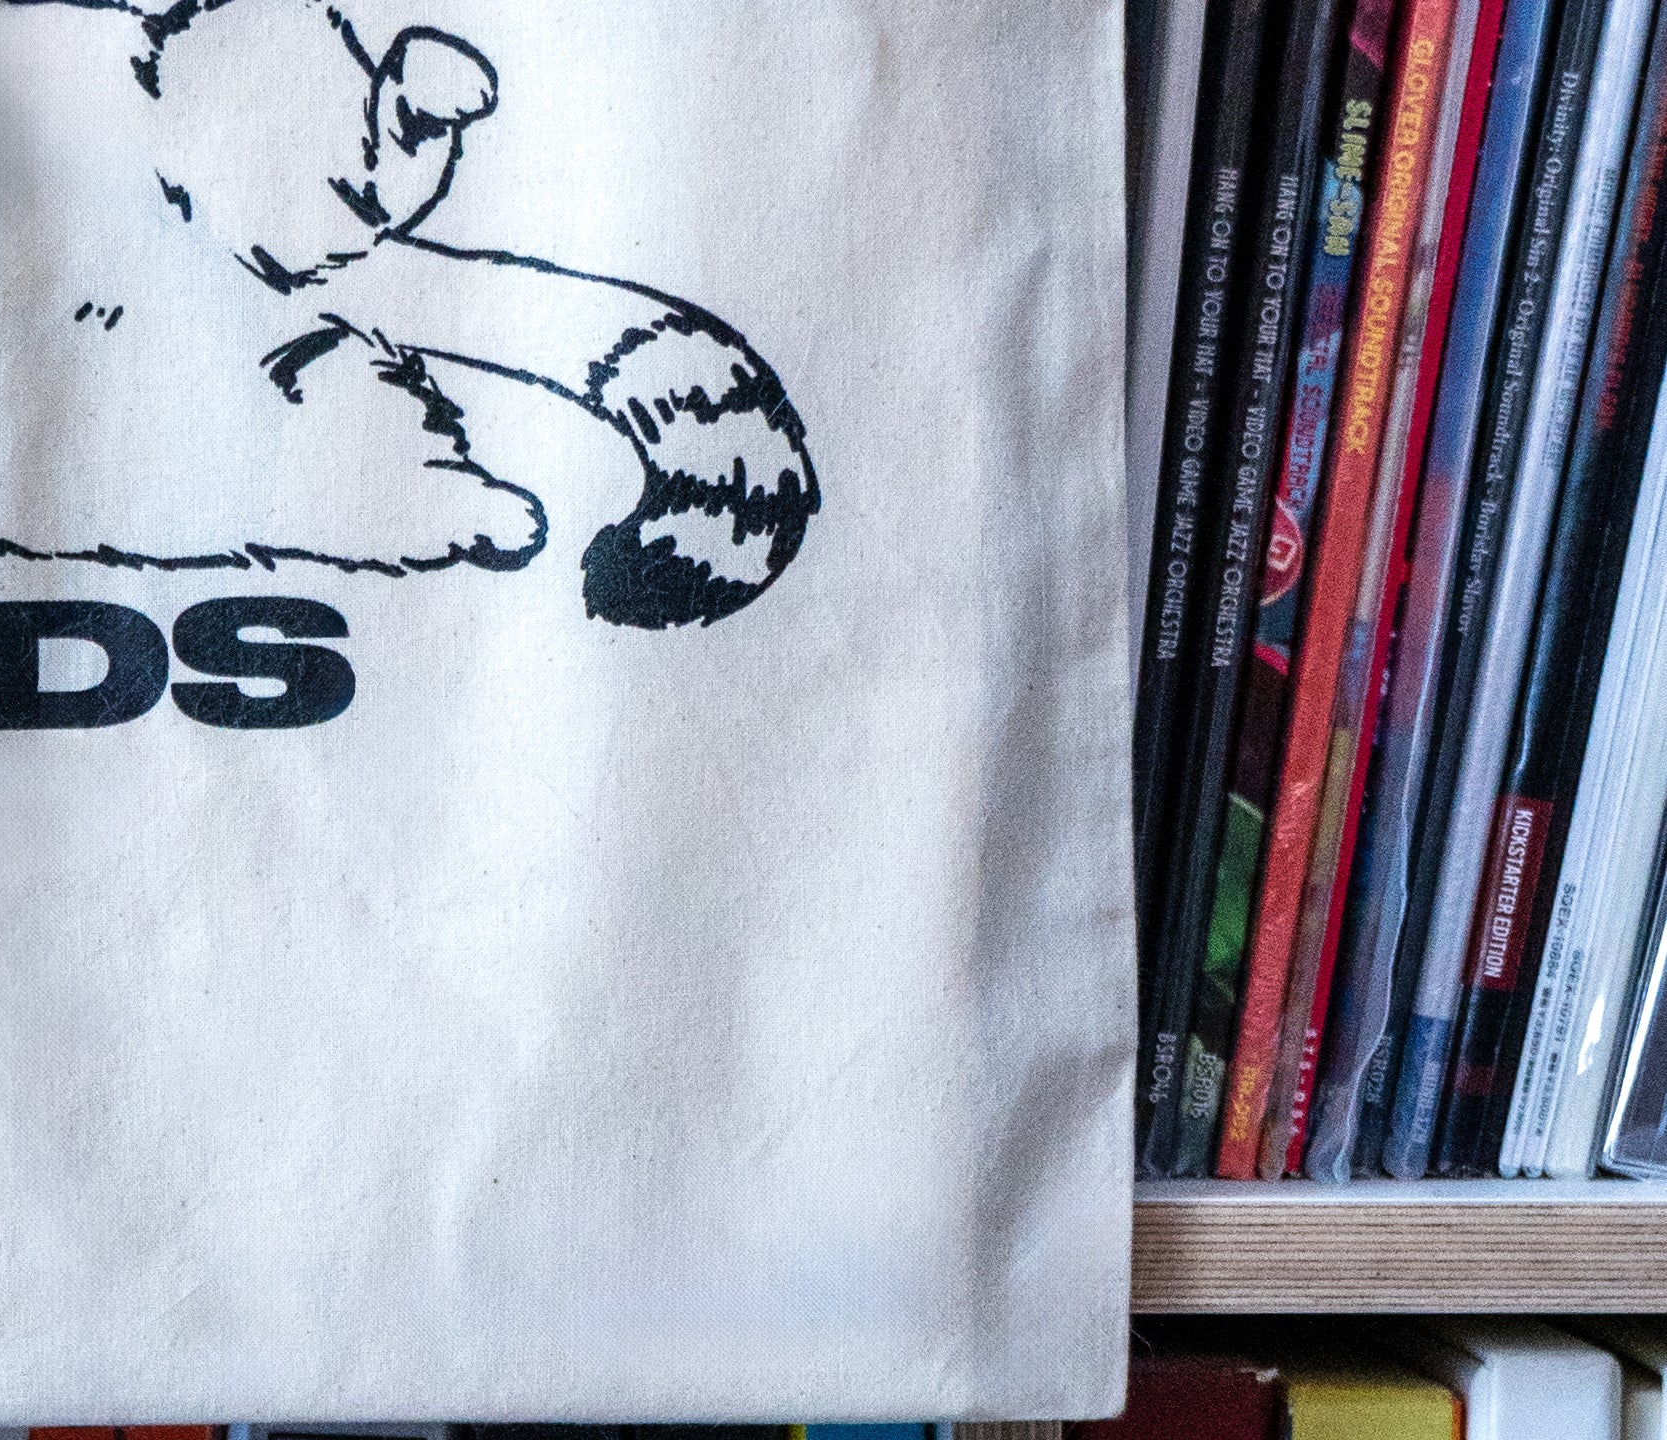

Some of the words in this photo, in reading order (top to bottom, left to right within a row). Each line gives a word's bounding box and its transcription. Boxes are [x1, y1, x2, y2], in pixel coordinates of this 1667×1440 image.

[1398, 38, 1434, 146] GLOVER
[1546, 71, 1580, 153] Divinity:
[1213, 168, 1238, 213] HANG
[1275, 175, 1299, 220] HANG
[1324, 99, 1372, 257] SLIME-SAN
[1532, 158, 1564, 234] Original
[1209, 218, 1232, 249] ON
[1376, 150, 1416, 268] ORIGINAL
[1270, 226, 1293, 256] ON
[1526, 238, 1550, 268] Sin
[1204, 254, 1228, 284] TO
[1265, 263, 1287, 290] TO
[1524, 271, 1540, 283] 2
[1198, 289, 1223, 338] YOUR
[1258, 296, 1282, 345] YOUR
[1504, 299, 1535, 377] Original
[1192, 345, 1214, 376] HAT
[1251, 348, 1274, 383] HAT
[1344, 278, 1394, 455] SOUNDTRACK
[1183, 398, 1210, 452] VIDEO
[1241, 406, 1266, 459] VIDEO
[1286, 385, 1323, 512] SOUNDTRACK
[1485, 380, 1523, 483] Soundtrack
[1177, 458, 1202, 507] GAME
[1233, 465, 1258, 515] GAME
[1170, 511, 1195, 555] JAZZ
[1225, 520, 1248, 562] JAZZ
[1468, 500, 1498, 572] Borislav
[1156, 559, 1188, 661] ORCHESTRA
[1209, 566, 1245, 668] ORCHESTRA
[1455, 576, 1484, 637] Slavov
[1495, 809, 1534, 914] KICKSTARTER
[1484, 916, 1514, 978] EDITION
